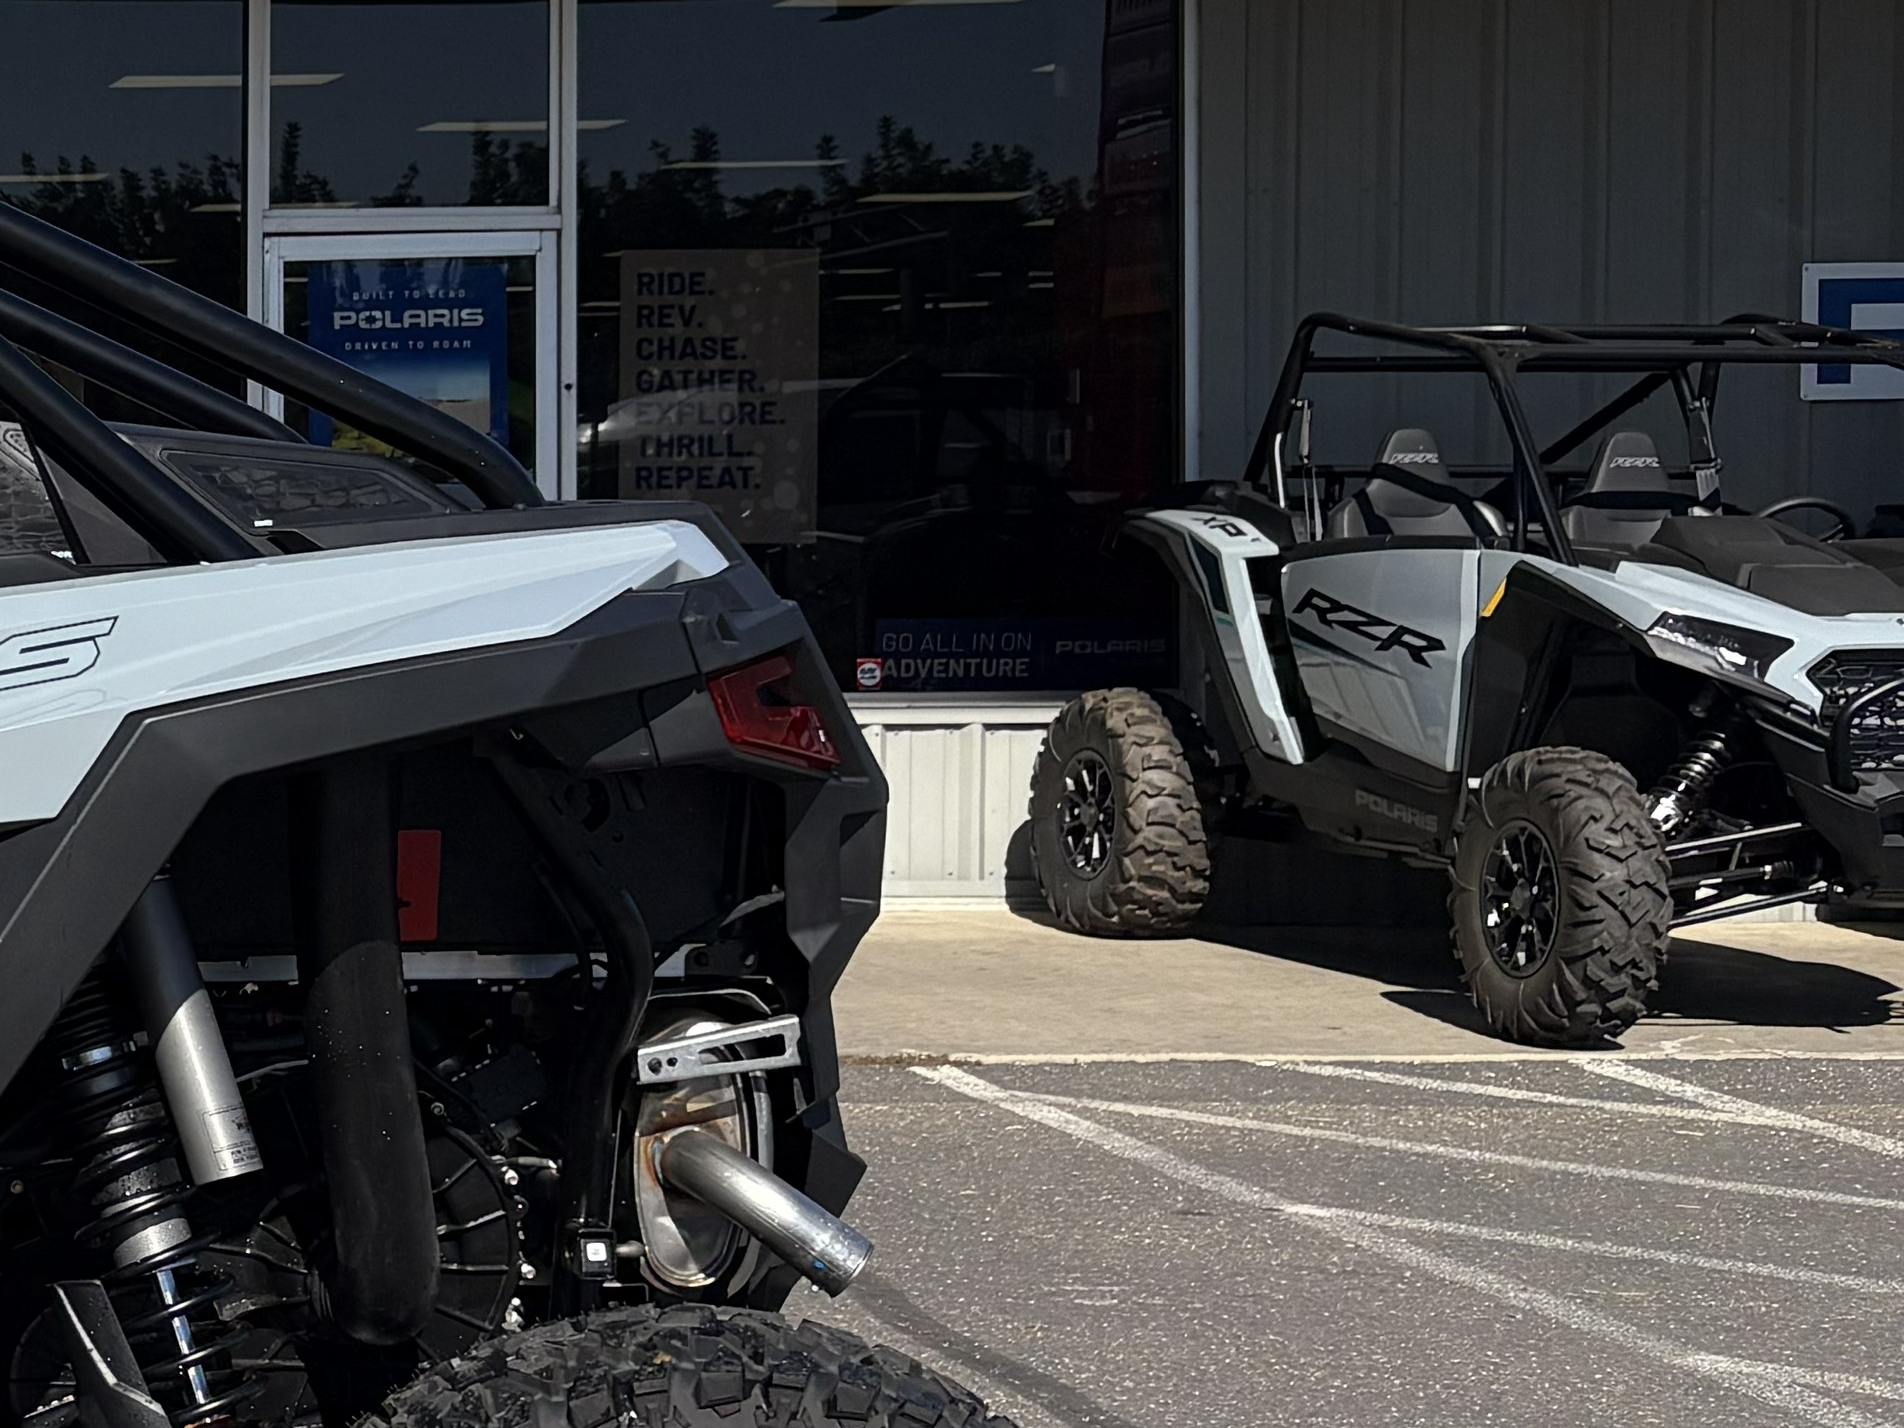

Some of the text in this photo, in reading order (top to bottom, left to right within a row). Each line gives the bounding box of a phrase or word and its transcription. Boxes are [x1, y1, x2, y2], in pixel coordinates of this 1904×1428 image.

[352, 288, 466, 301] BUILT TO LEAD
[635, 271, 714, 296] RIDE.
[332, 307, 485, 331] POLARIS
[635, 304, 703, 328] REV.
[344, 339, 472, 351] DRIVEN TO ROAM
[635, 337, 746, 360] CHASE.
[635, 369, 765, 393] GATHER.
[635, 401, 786, 425] EXPLORE.
[637, 434, 753, 458] THRILL.
[634, 466, 761, 490] REPEAT.
[1292, 587, 1446, 669] RZR
[882, 631, 1032, 653] GO ALL IN ON
[1054, 637, 1168, 655] POLARIS
[882, 657, 1031, 679] ADVENTURE
[1354, 788, 1439, 834] POLARIS
